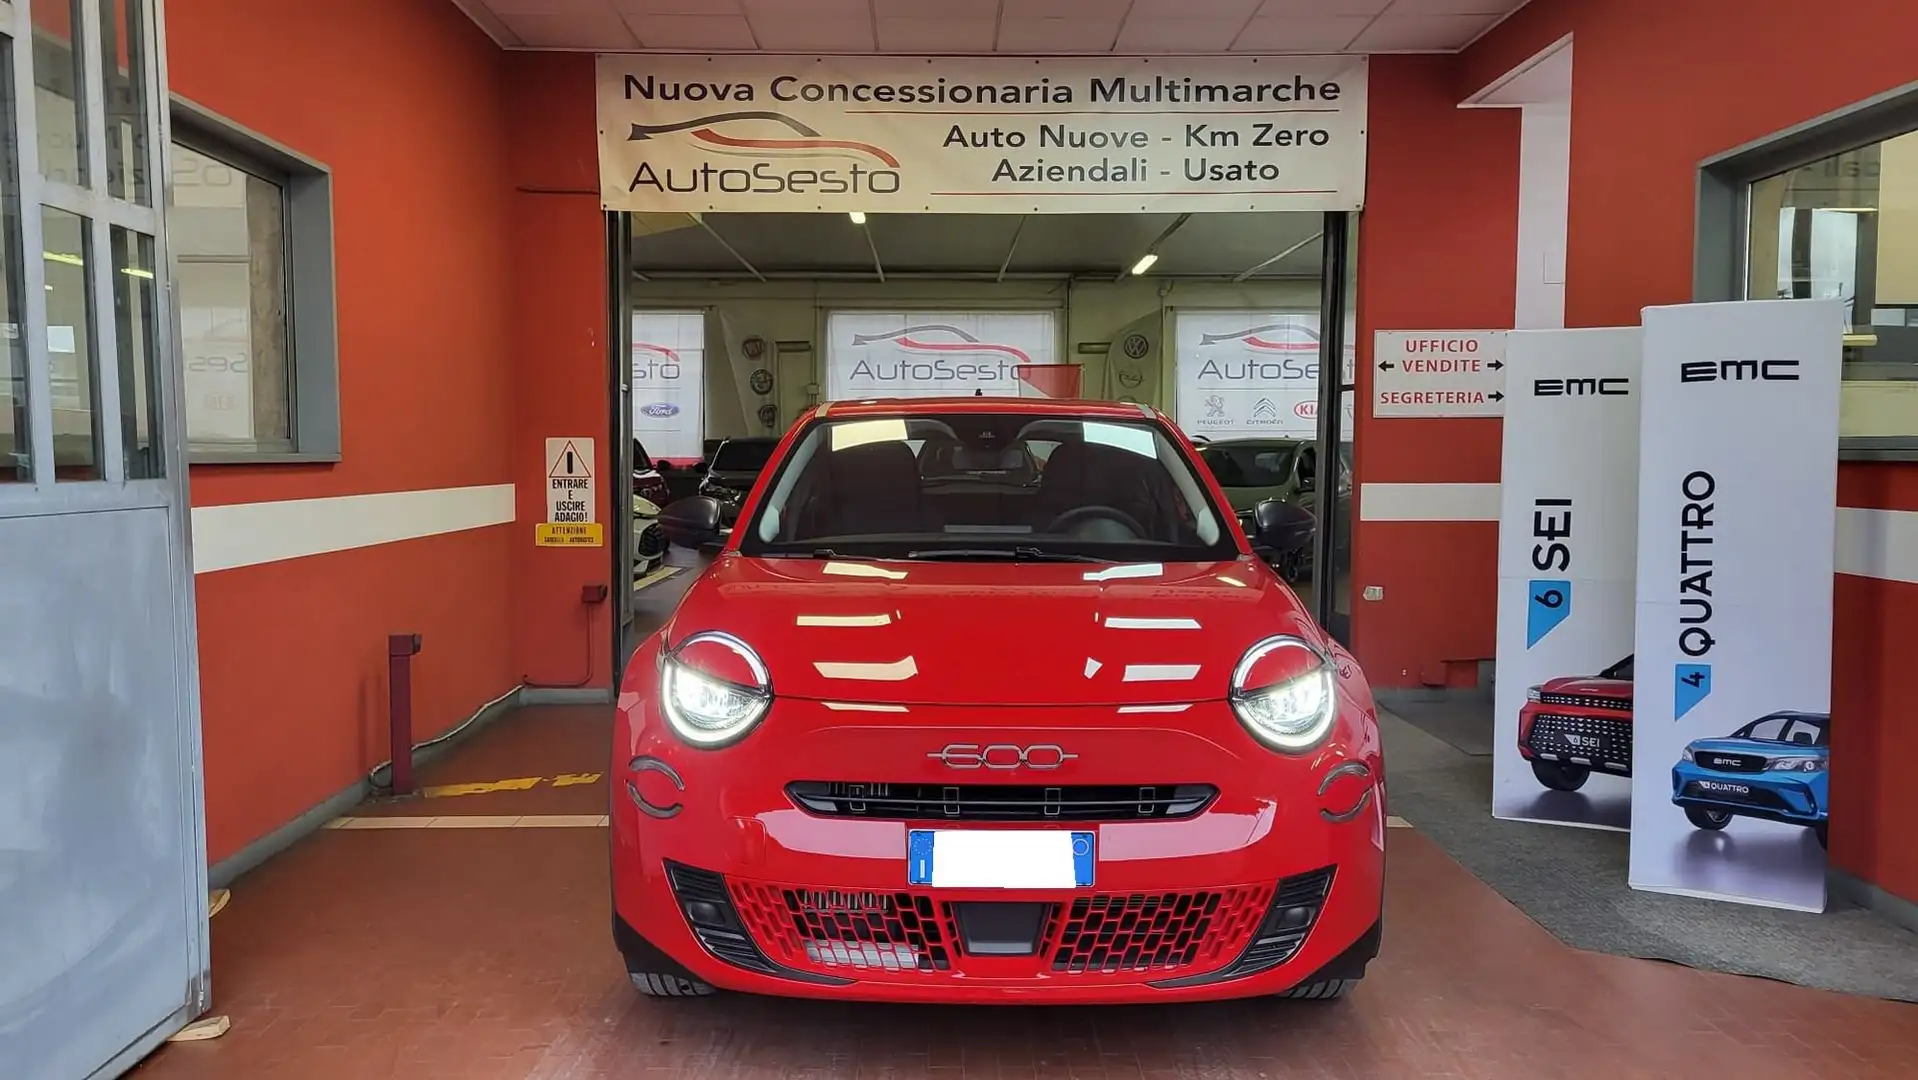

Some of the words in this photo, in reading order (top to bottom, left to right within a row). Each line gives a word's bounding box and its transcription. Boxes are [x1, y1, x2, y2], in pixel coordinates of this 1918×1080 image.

[623, 74, 755, 102] Nuova
[769, 76, 1074, 104] Concessionaria
[1089, 75, 1341, 104] Multimarche
[942, 124, 1027, 149] Auto
[1039, 124, 1149, 149] Nuove
[1184, 123, 1240, 148] Km
[1252, 122, 1331, 148] Zero
[628, 161, 901, 194] AutoSesto
[991, 157, 1148, 183] Aziendali
[1183, 157, 1281, 183] Usato
[1405, 339, 1479, 353] UFFICIO
[1402, 359, 1482, 373] VENDITE
[1380, 391, 1485, 404] SEGRETERIA
[1299, 404, 1318, 416] KI
[552, 479, 589, 490] ENTRARE
[567, 490, 574, 500] E
[556, 501, 586, 511] USCIRE
[554, 511, 589, 523] ADAGIO!
[1532, 498, 1573, 572] SEI
[1678, 470, 1716, 657] QUATTRO
[1534, 589, 1564, 609] 6
[1681, 671, 1706, 689] 4
[939, 743, 1066, 770] 600
